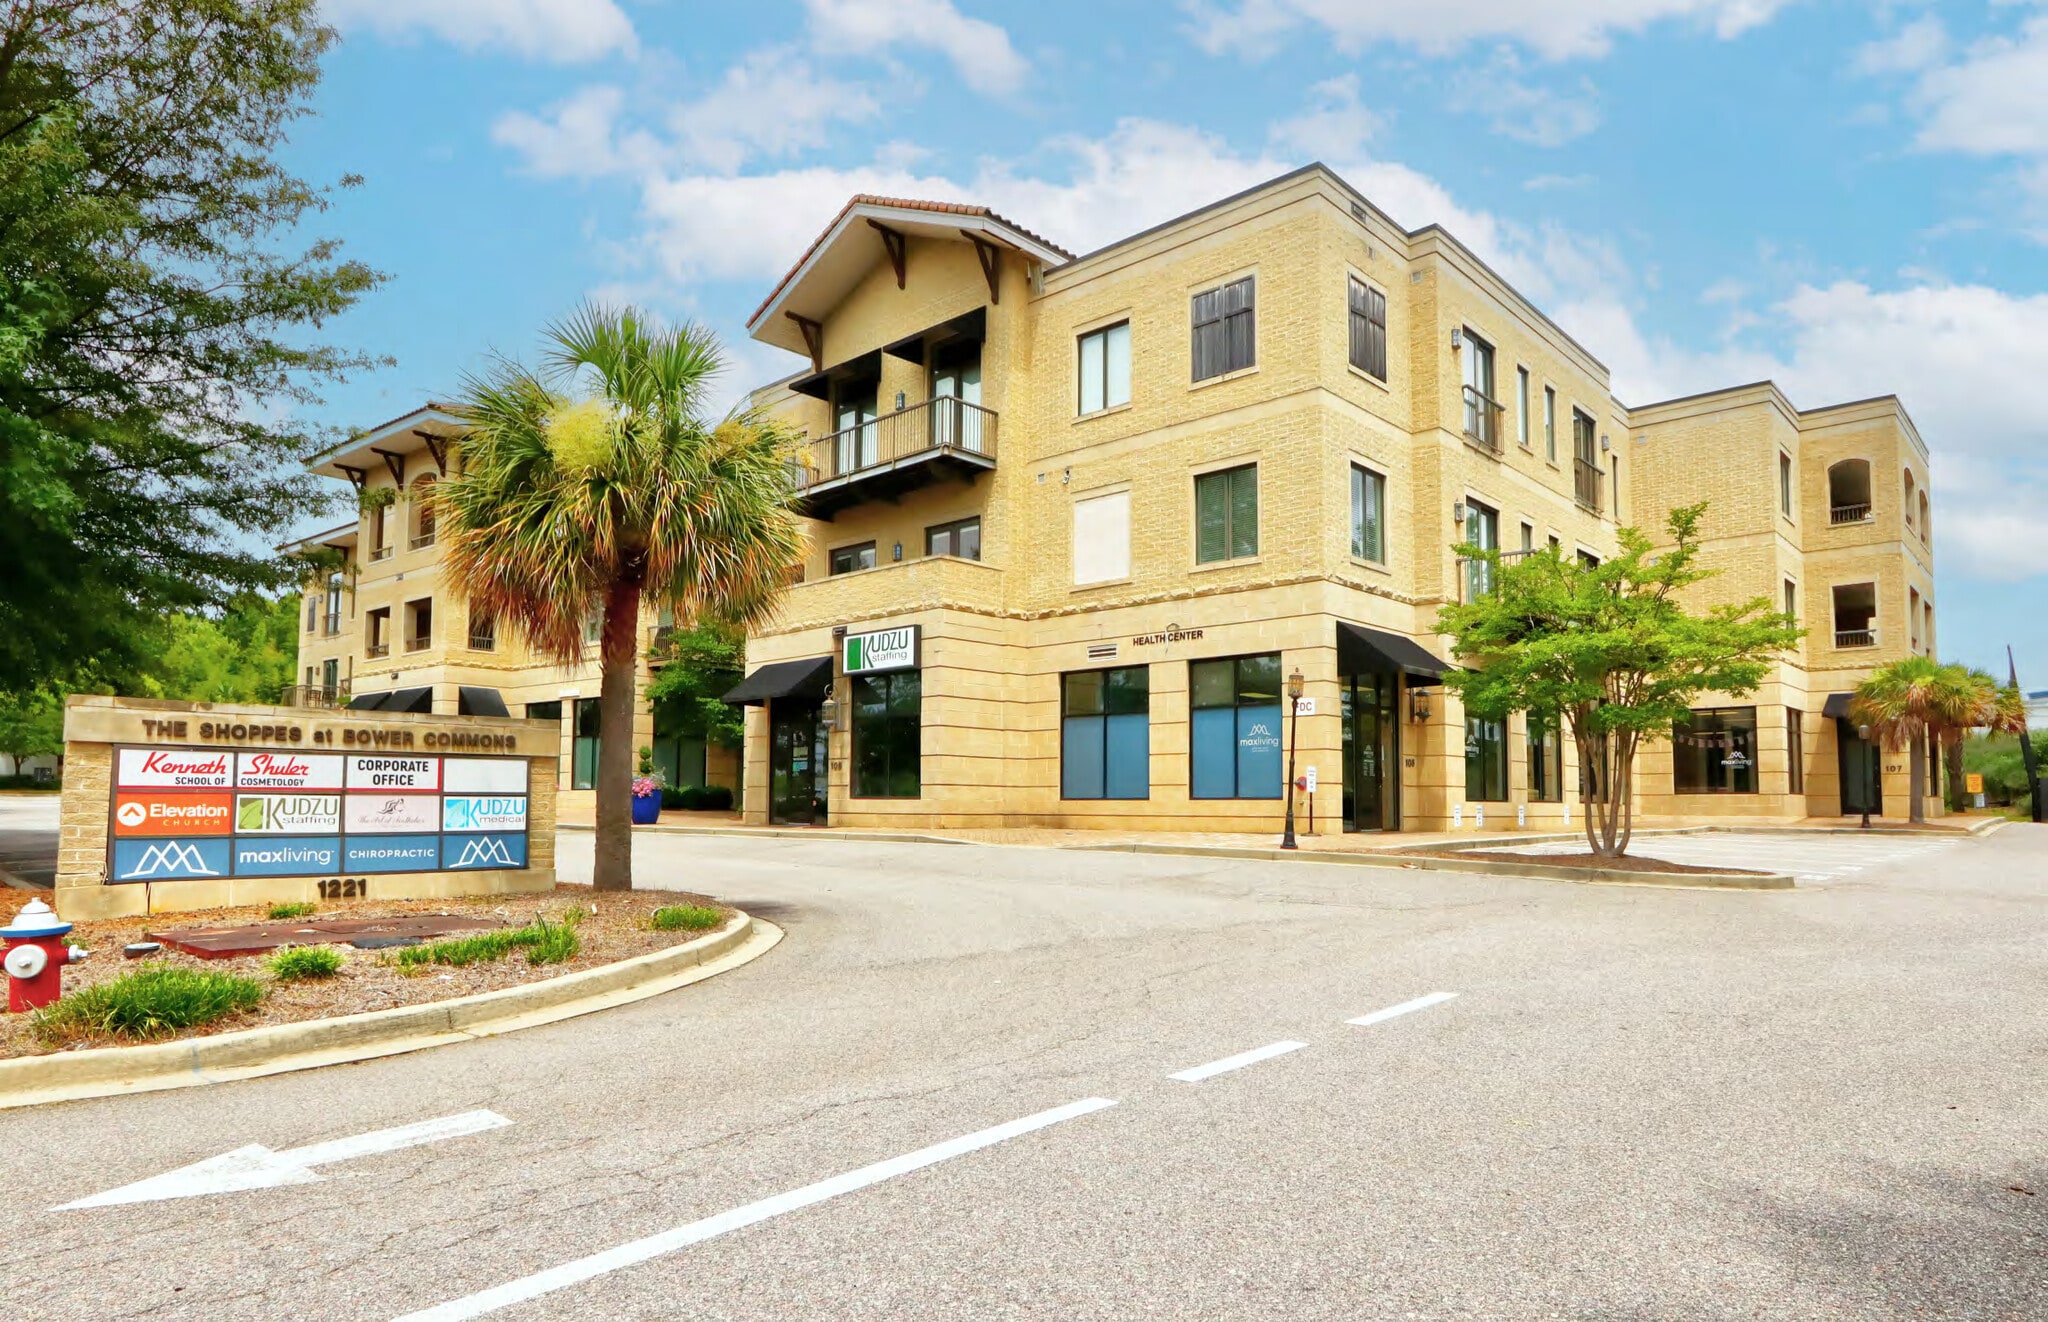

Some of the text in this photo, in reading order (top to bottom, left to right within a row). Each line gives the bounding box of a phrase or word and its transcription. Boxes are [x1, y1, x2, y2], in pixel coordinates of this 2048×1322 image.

[1133, 630, 1203, 646] HEALTH CENTER
[863, 630, 908, 669] KUDZU
[872, 651, 907, 662] staffing
[142, 719, 516, 749] THE SHOPPES at BOWER COMMONS
[1240, 737, 1279, 747] maxliving
[142, 752, 226, 774] Kenneth
[242, 753, 309, 776] Shuler
[357, 759, 429, 772] CORPORATE
[175, 777, 211, 785] SCHOOL
[240, 778, 304, 786] COSMETOLOGY
[372, 774, 414, 786] OFFICE
[150, 803, 228, 817] Elevation
[266, 798, 338, 829] KUDZU
[466, 799, 525, 828] KUDZU
[162, 818, 220, 826] CHURCH
[282, 816, 336, 825] staffing
[239, 847, 334, 865] maxliving
[349, 849, 435, 859] CHIROPRACTIC
[317, 878, 367, 898] 1221
